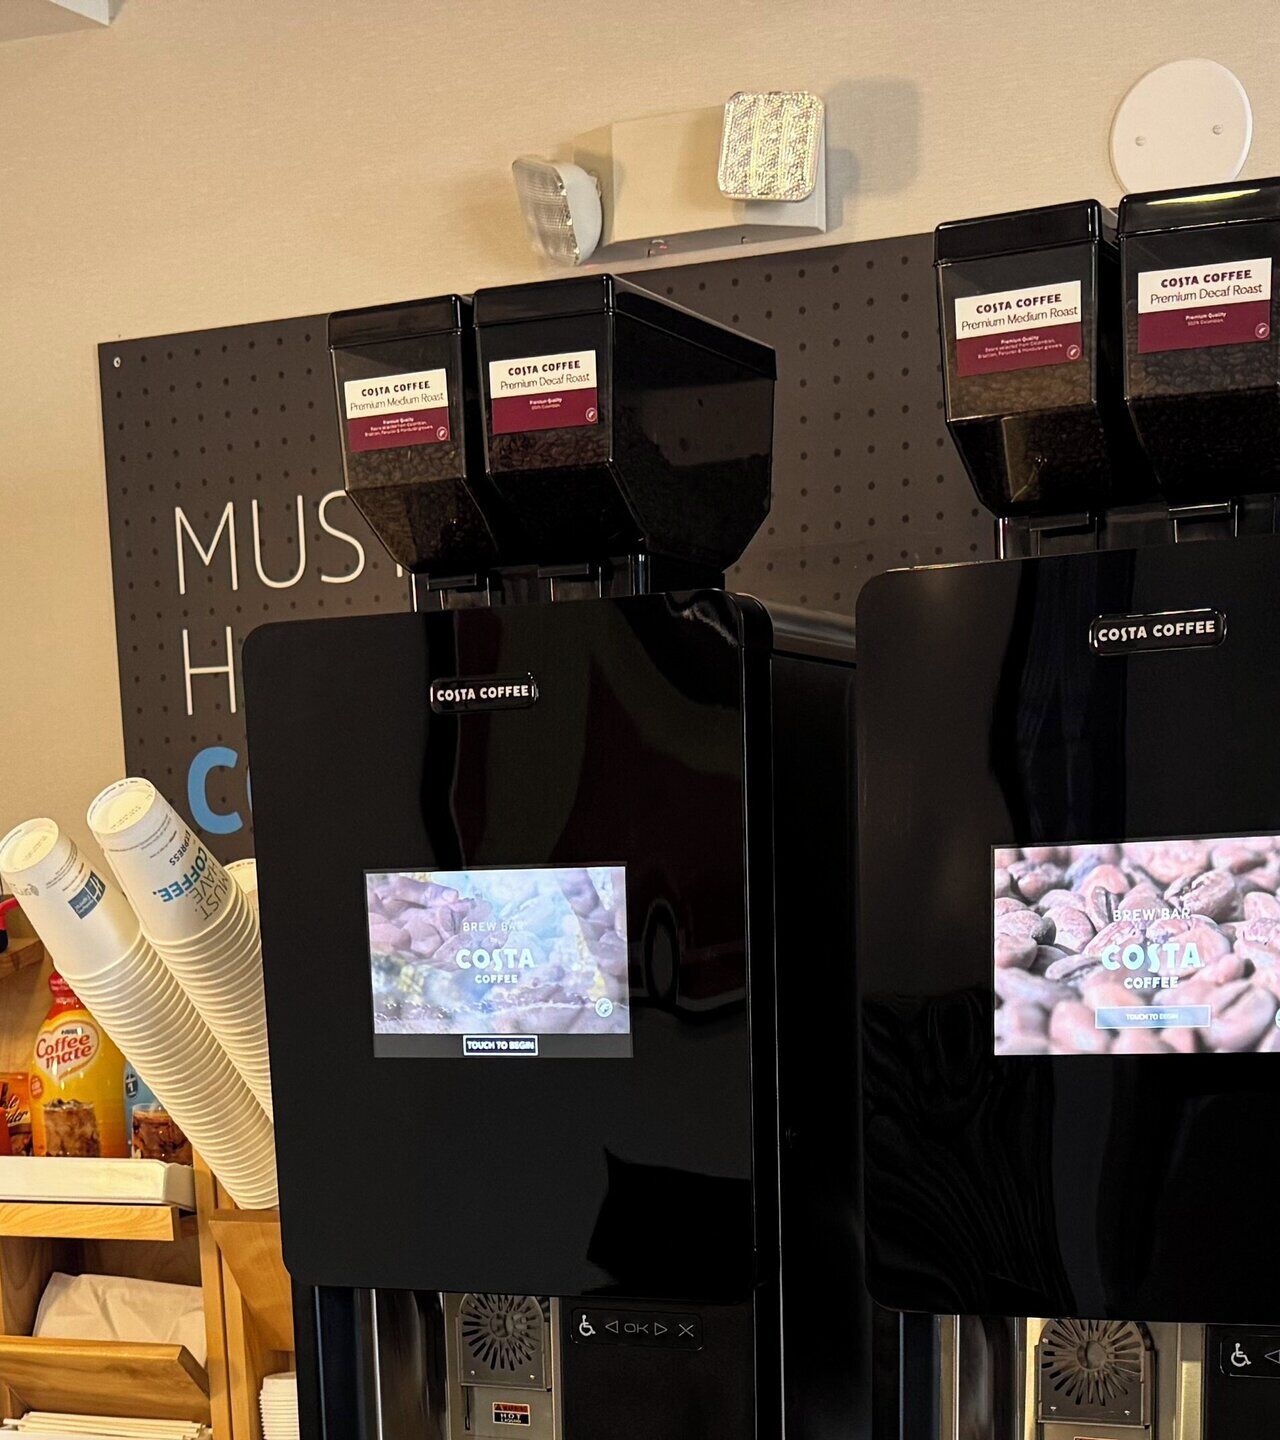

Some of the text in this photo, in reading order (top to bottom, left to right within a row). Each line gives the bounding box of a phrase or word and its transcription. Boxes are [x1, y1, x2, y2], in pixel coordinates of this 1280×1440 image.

[1161, 269, 1252, 288] COSTA COFFEE
[976, 293, 1062, 314] COSTA COFFEE
[1150, 284, 1263, 304] Premium Decaf Roast
[961, 306, 1078, 331] Premium Medium Roast
[508, 360, 581, 376] COSTA COFFEE
[361, 380, 431, 397] COSTA COFFEE
[500, 373, 590, 390] Premium Decaf Roast
[350, 392, 444, 412] Premium Medium Roast
[175, 490, 403, 594] MUS
[1098, 620, 1215, 642] COSTA COFFEE
[436, 684, 529, 702] COSTA COFFEE
[1113, 908, 1191, 921] BREW BAR
[462, 922, 497, 932] BREW
[455, 948, 536, 971] COSTA
[1101, 942, 1202, 973] COSTA
[474, 974, 518, 984] COFFEE
[1123, 976, 1180, 989] COFFEE
[36, 1034, 90, 1058] Coffee
[466, 1041, 535, 1050] TOUCH TO BEGIN
[46, 1045, 92, 1069] mate
[624, 1323, 649, 1334] OK
